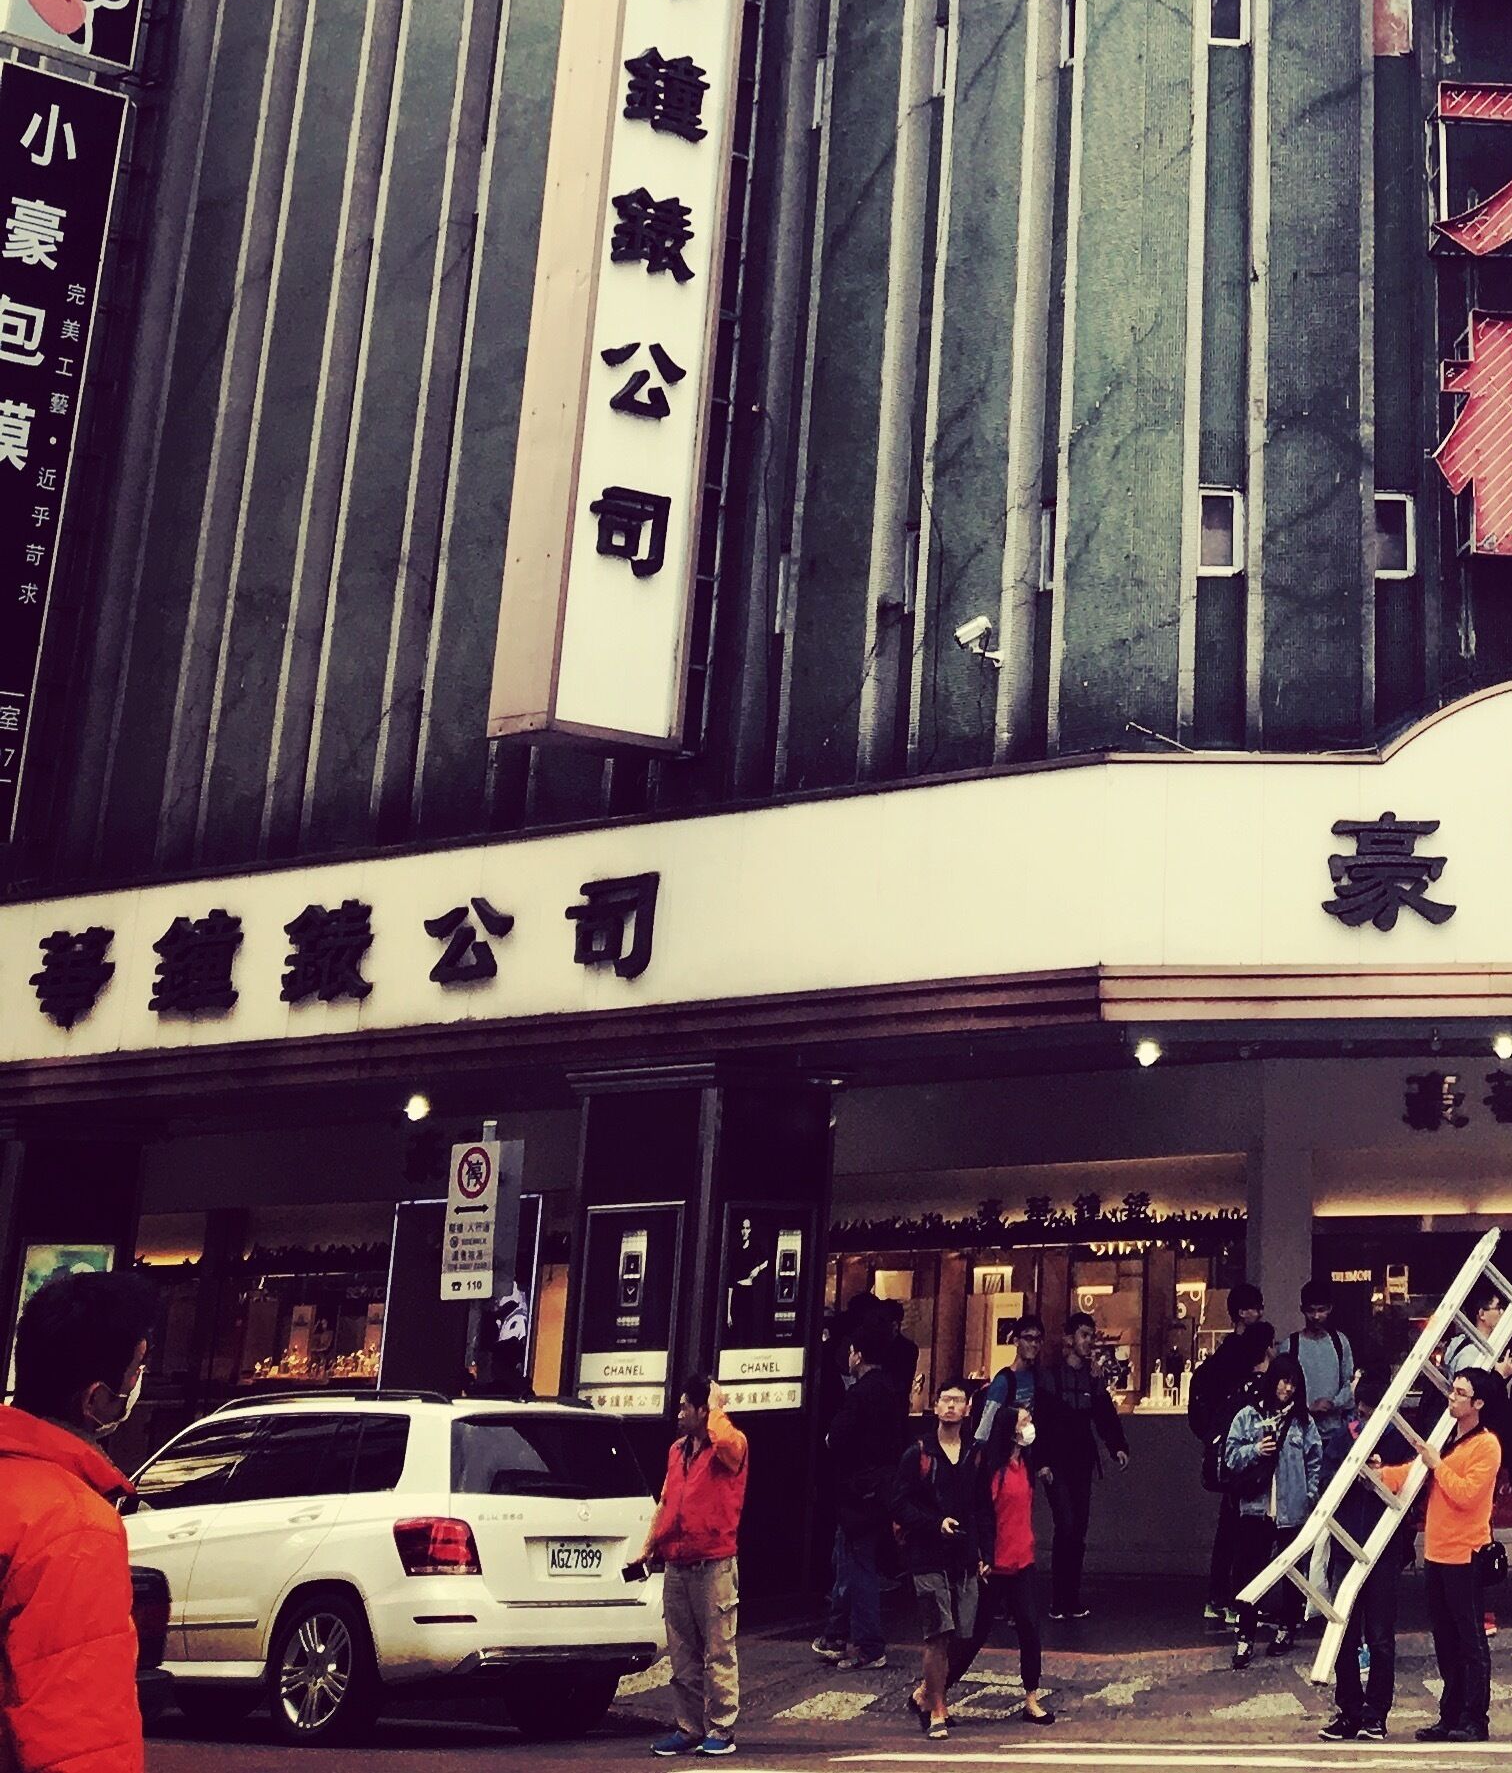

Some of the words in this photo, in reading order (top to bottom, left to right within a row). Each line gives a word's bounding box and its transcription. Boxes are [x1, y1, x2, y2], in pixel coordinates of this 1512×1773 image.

[28, 870, 662, 1030] 華鐘錶公司
[464, 1159, 484, 1188] 停
[466, 1280, 483, 1291] 110
[603, 1365, 645, 1376] CHANEL
[740, 1362, 781, 1373] CHANEL
